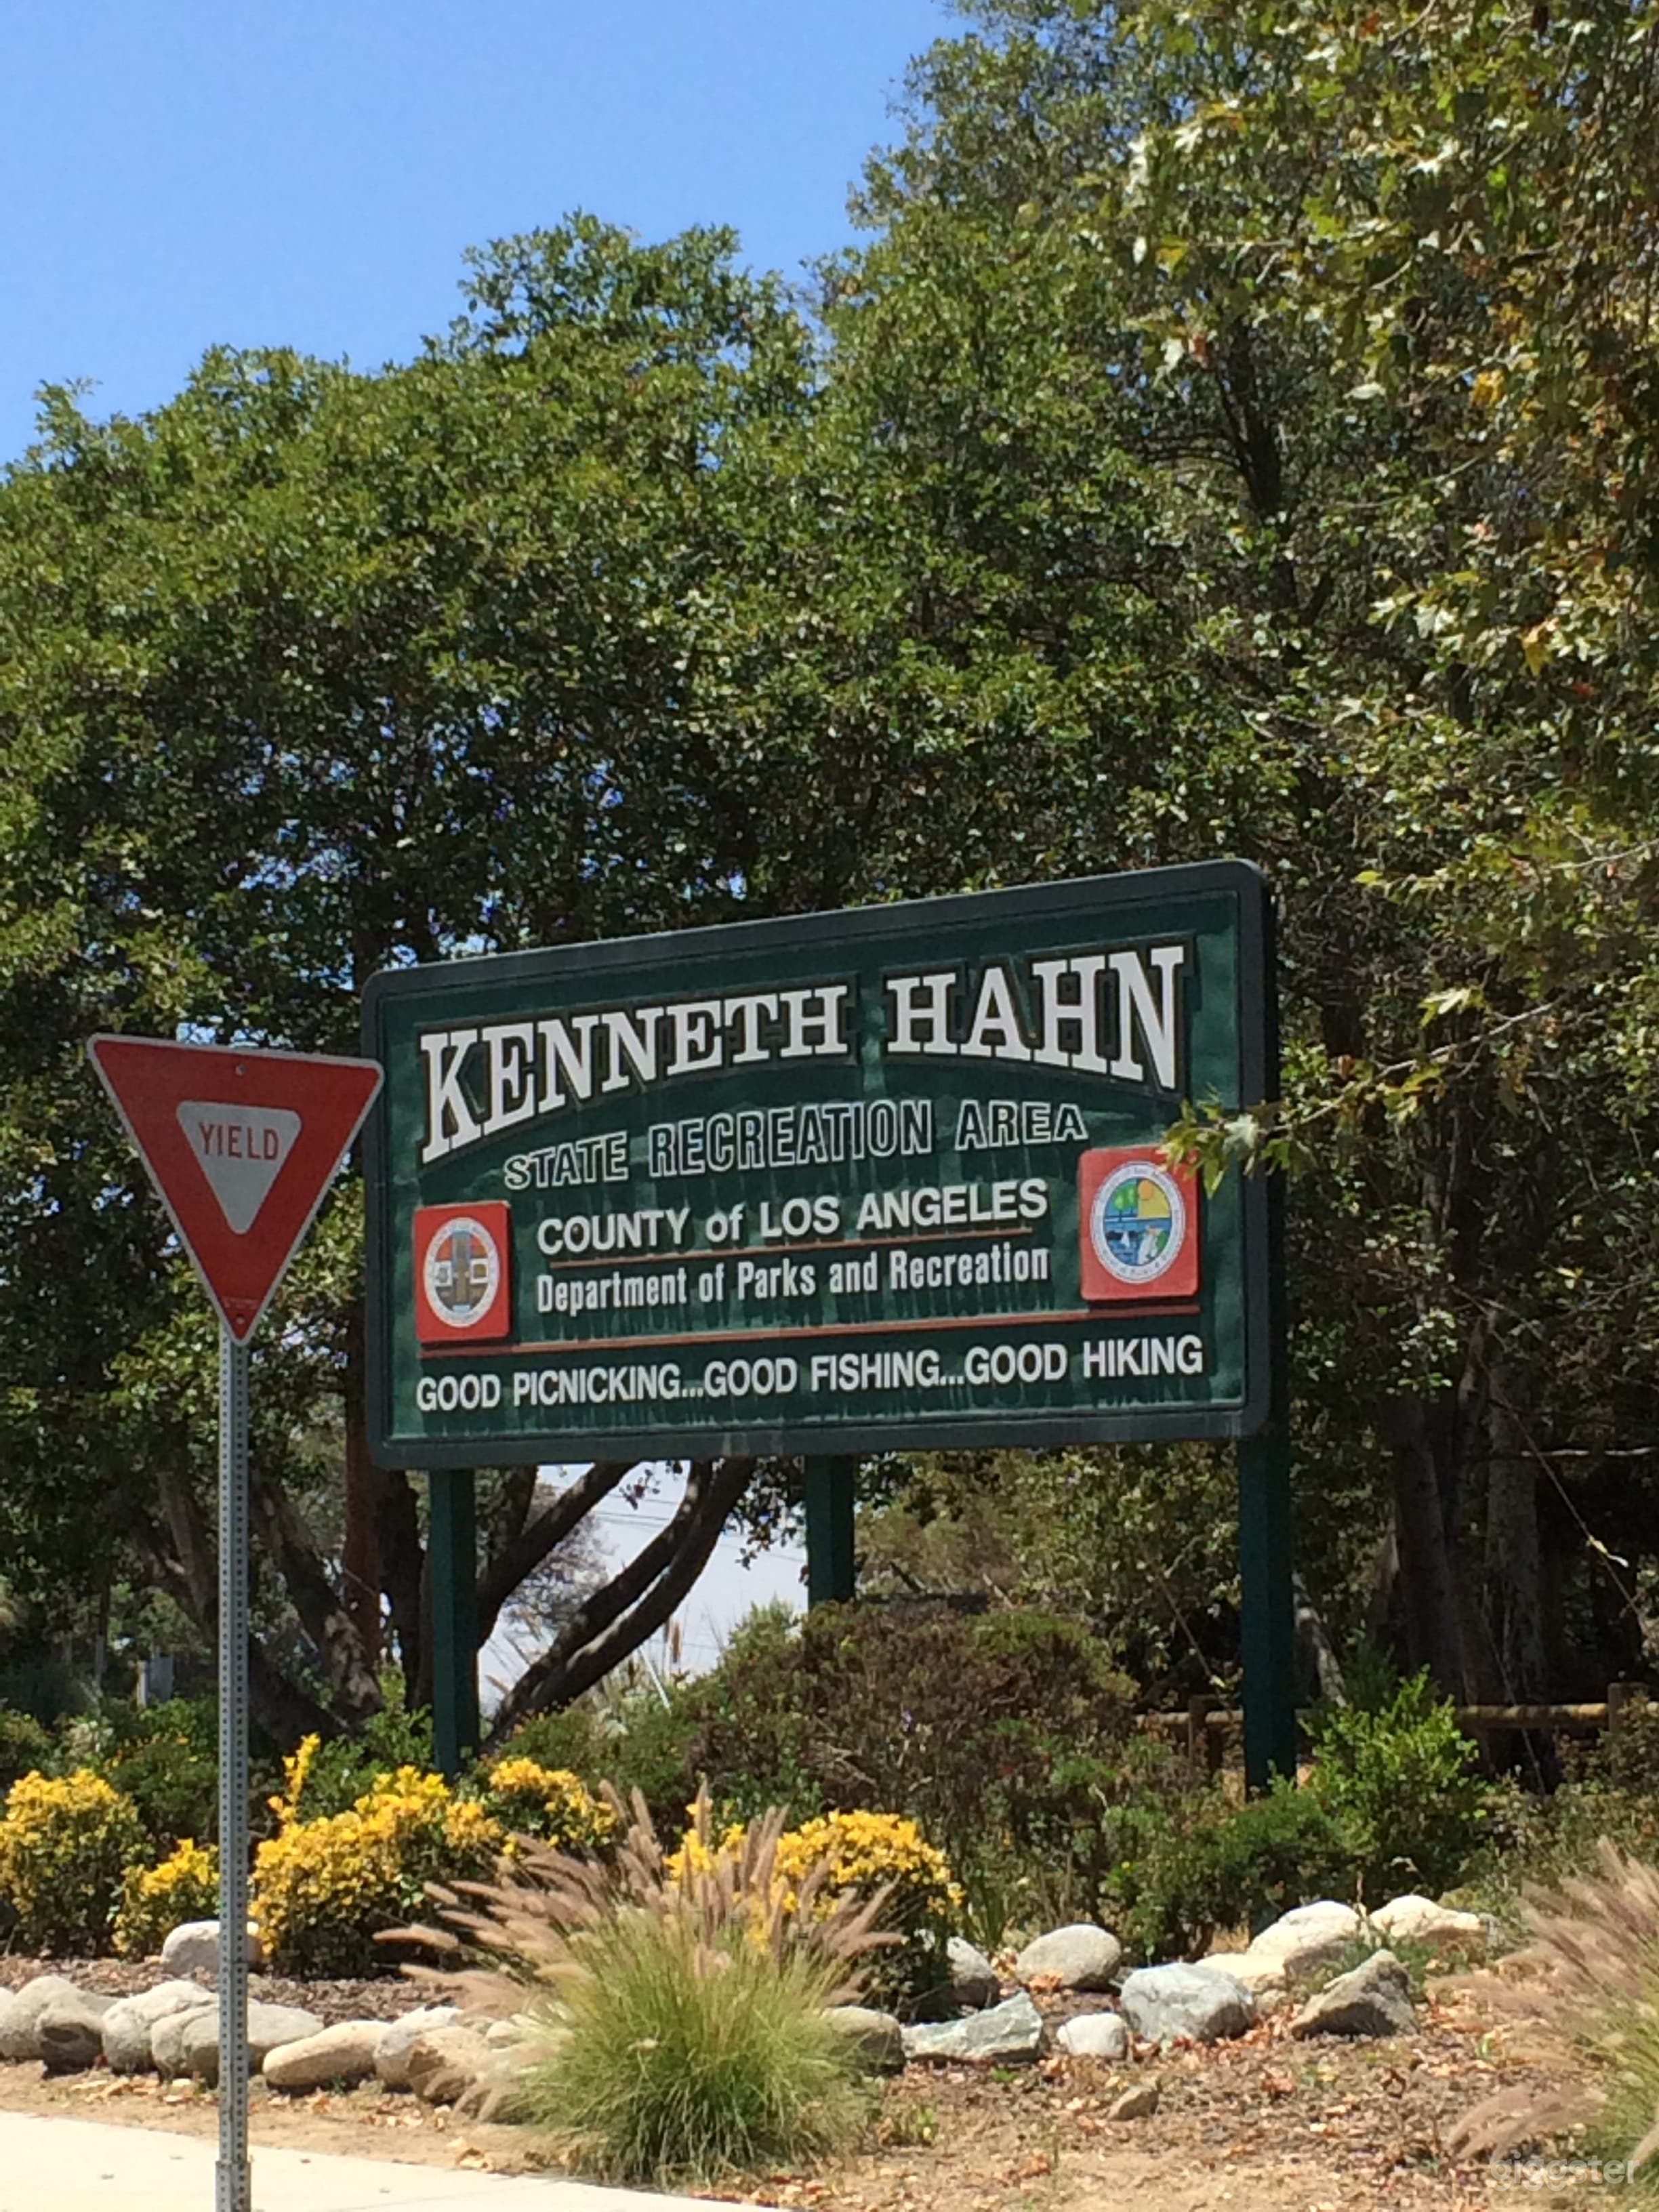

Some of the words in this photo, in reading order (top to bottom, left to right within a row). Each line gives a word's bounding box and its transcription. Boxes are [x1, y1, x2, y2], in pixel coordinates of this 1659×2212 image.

[419, 989, 848, 1165] KENNETH
[886, 946, 1184, 1089] HAHN
[200, 1123, 280, 1160] YIELD
[504, 1132, 629, 1189] STATE
[649, 1101, 933, 1178] RECREATION
[955, 1101, 1088, 1151] AREA
[537, 1208, 690, 1254] COUNTY
[706, 1206, 743, 1242] of
[760, 1196, 840, 1237] LOS
[857, 1179, 1048, 1231] ANGELES
[537, 1266, 688, 1316] Department
[699, 1267, 724, 1303] of
[739, 1258, 816, 1299] Parks
[829, 1252, 878, 1294] and
[890, 1242, 1049, 1290] Recreation
[417, 1374, 501, 1412] GOOD
[1083, 1335, 1203, 1378] HIKING
